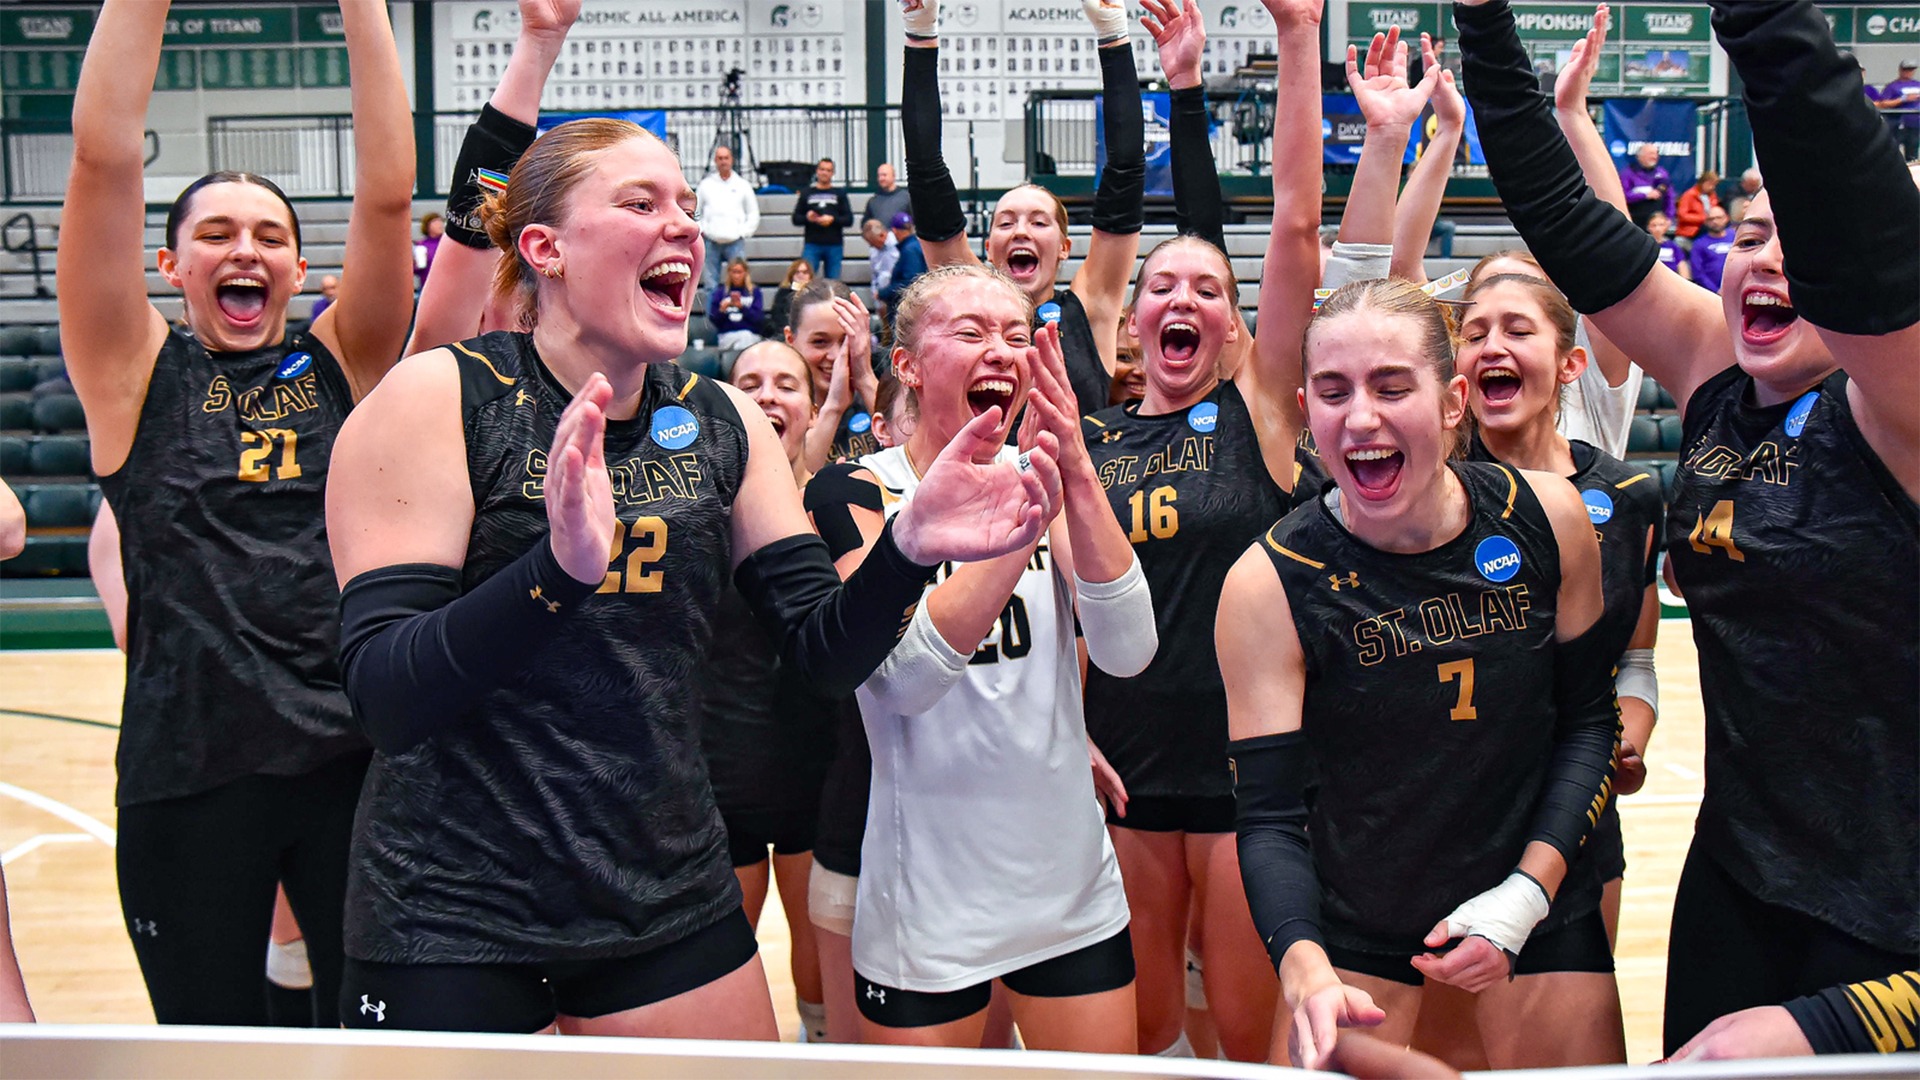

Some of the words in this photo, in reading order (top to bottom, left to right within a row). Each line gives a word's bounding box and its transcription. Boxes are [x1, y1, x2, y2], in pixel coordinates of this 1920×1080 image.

[577, 11, 631, 24] ADEMIC
[1008, 7, 1083, 21] ACADEMIC
[210, 17, 262, 33] TITANS
[281, 354, 310, 377] NCAA
[657, 422, 697, 441] NCAA
[1128, 485, 1179, 543] 16
[1483, 553, 1520, 574] NCAA
[1353, 608, 1422, 667] ST.
[1419, 583, 1531, 646] OLAF
[1437, 657, 1477, 720] 7
